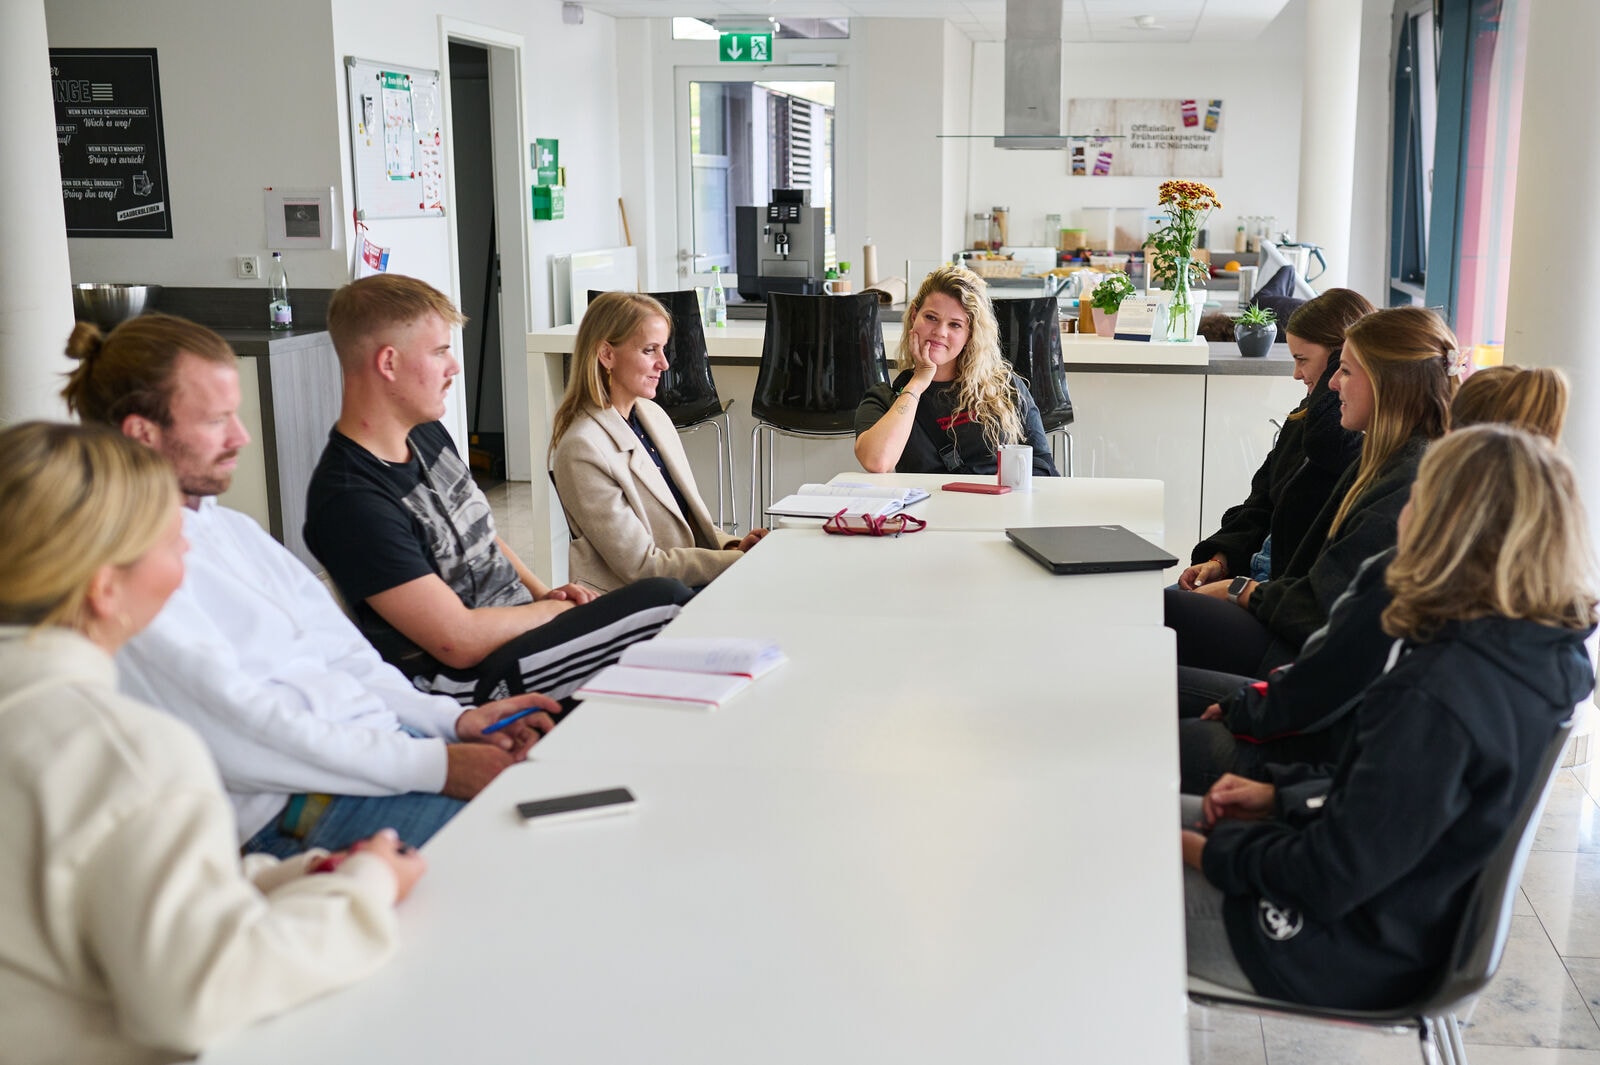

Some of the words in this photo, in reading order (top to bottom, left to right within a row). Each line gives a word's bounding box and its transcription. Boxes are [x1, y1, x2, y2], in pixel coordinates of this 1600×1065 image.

[53, 80, 92, 102] NGE
[84, 118, 104, 127] Wisch
[115, 118, 131, 129] weg!
[1131, 133, 1211, 142] Frühstückspartner
[1168, 142, 1208, 151] Nürnberg
[88, 154, 108, 166] Bring
[119, 154, 145, 164] zurück!
[63, 189, 82, 200] Bring
[98, 188, 117, 201] weg!
